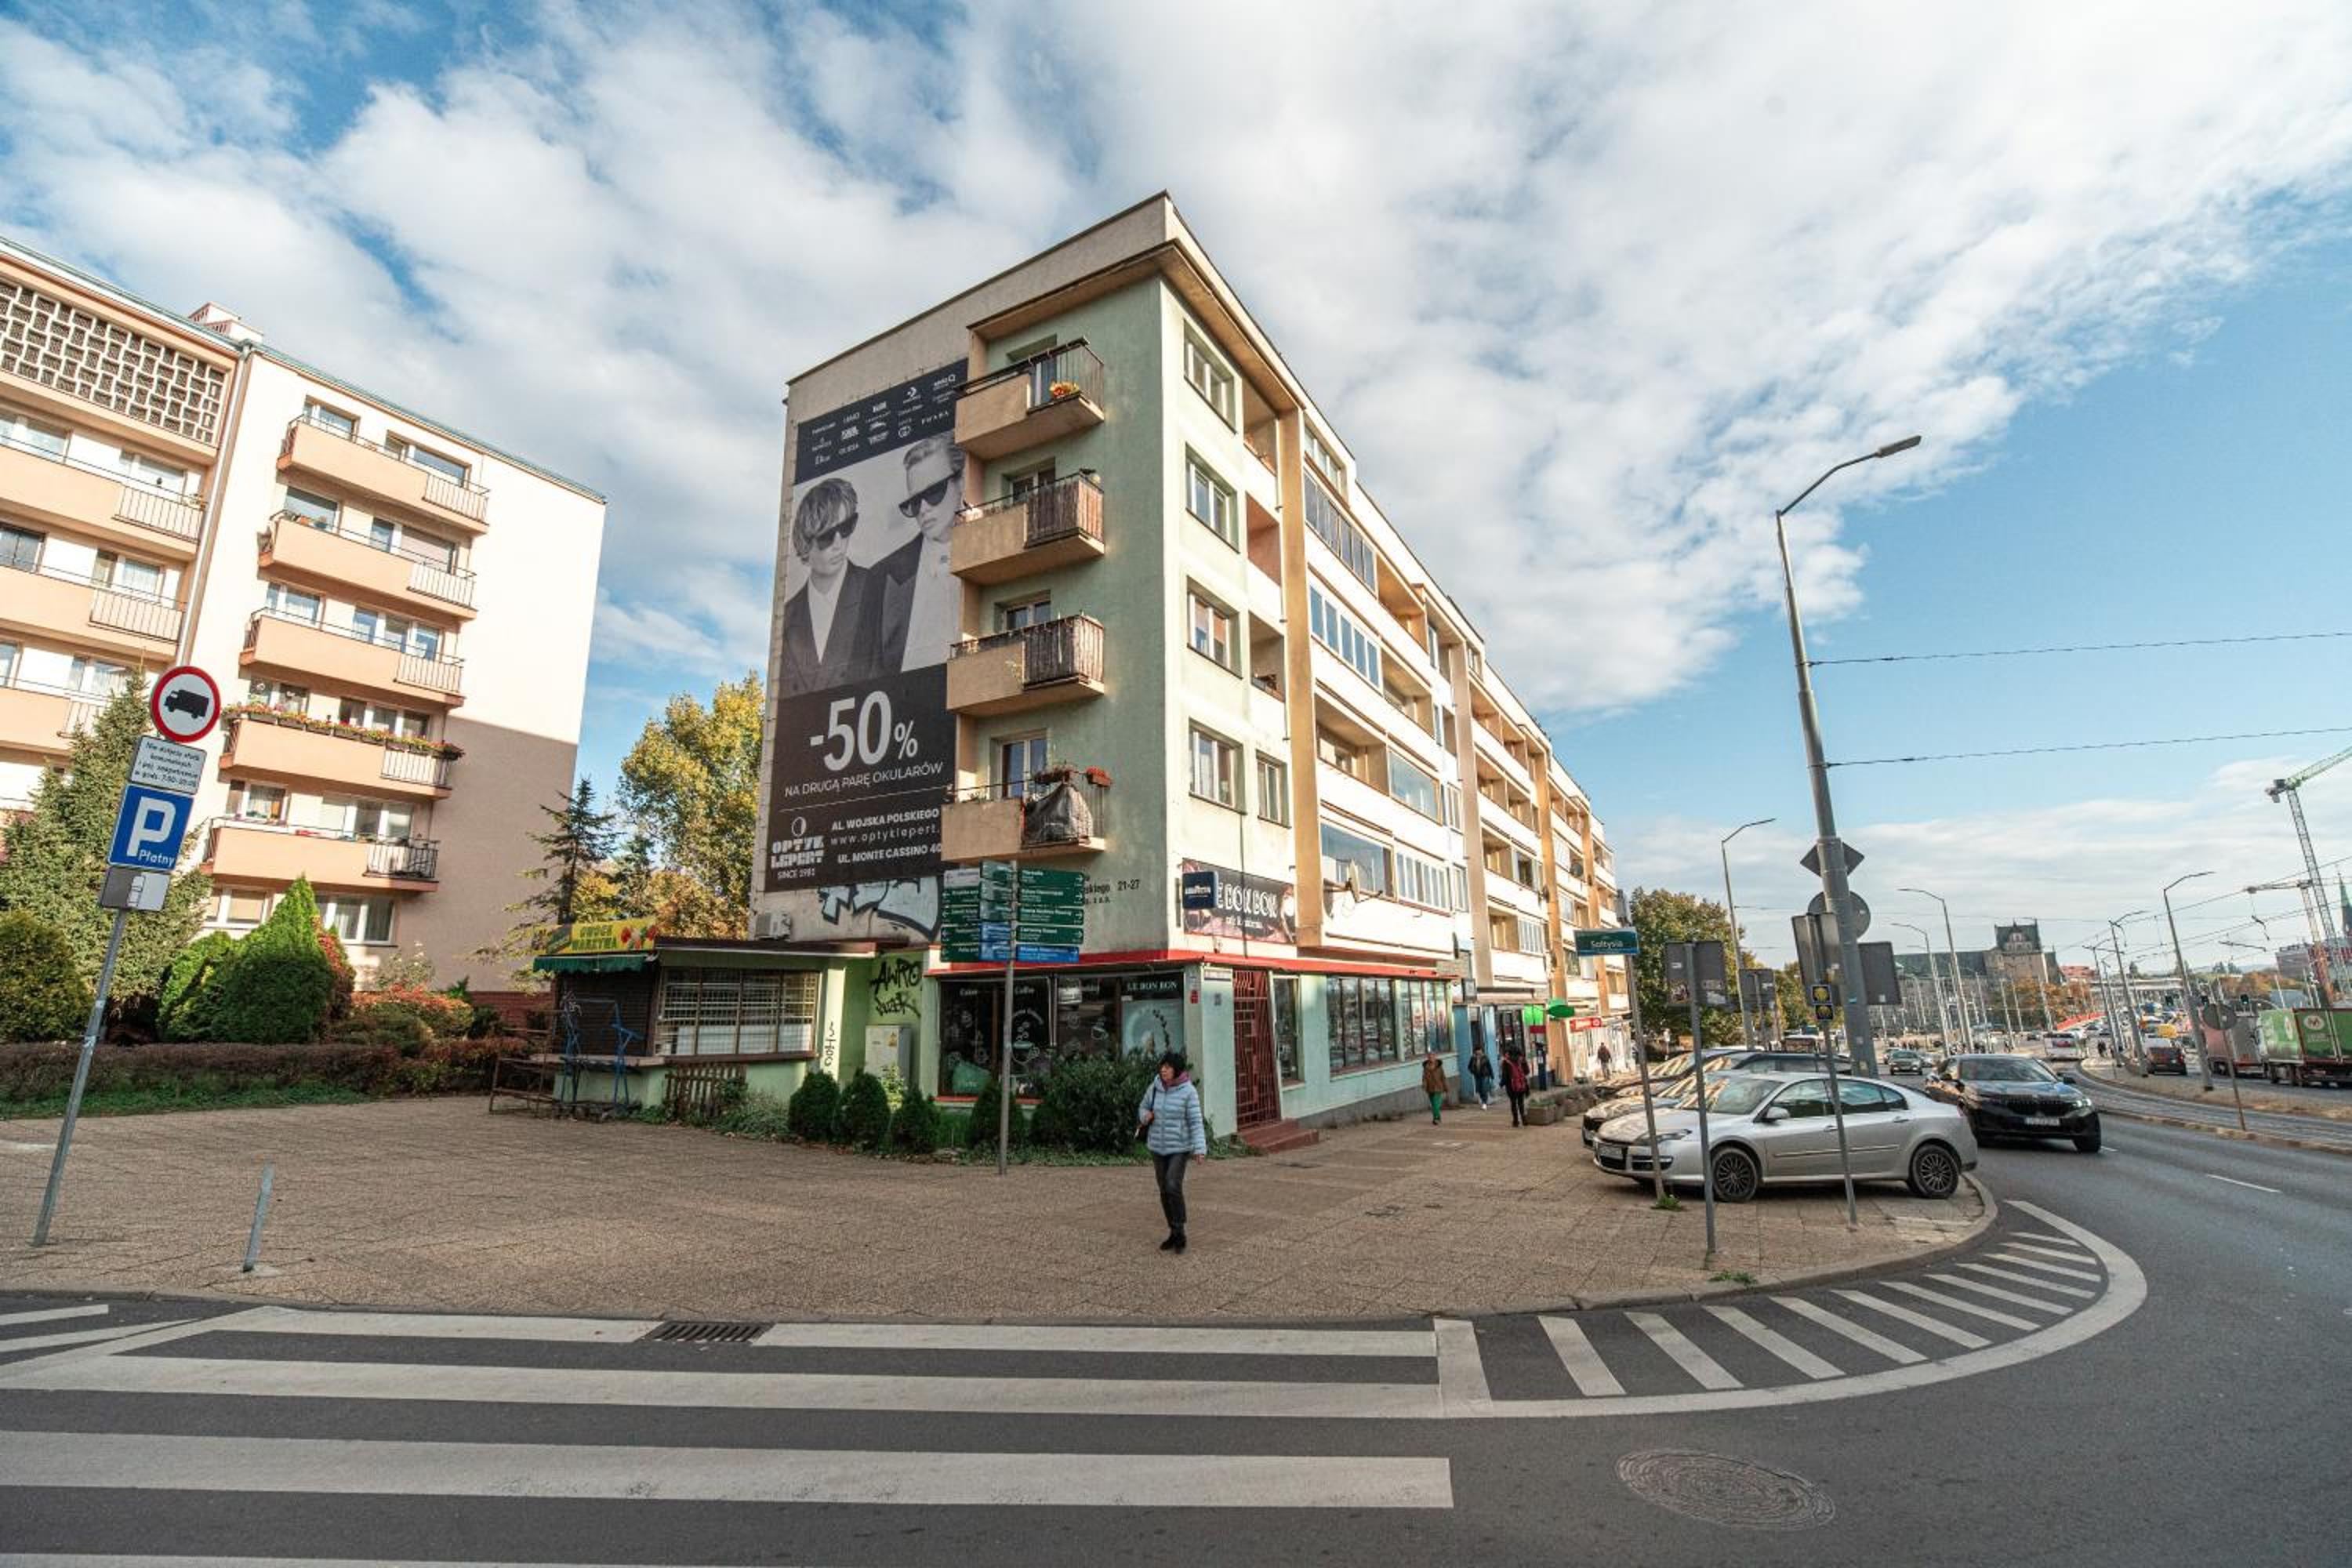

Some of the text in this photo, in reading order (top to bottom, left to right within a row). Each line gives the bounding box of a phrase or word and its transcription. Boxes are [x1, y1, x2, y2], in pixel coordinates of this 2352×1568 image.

[810, 691, 918, 771] -50%
[785, 761, 943, 797] NA DRUGĄ PARĘ OKULARÓW
[127, 797, 176, 856] P
[847, 816, 885, 829] WOJSKA
[887, 808, 939, 823] POLSKIEGO
[852, 849, 884, 862] MONTE
[885, 844, 927, 858] CASSINO
[1085, 879, 1140, 895] skiego 21-27
